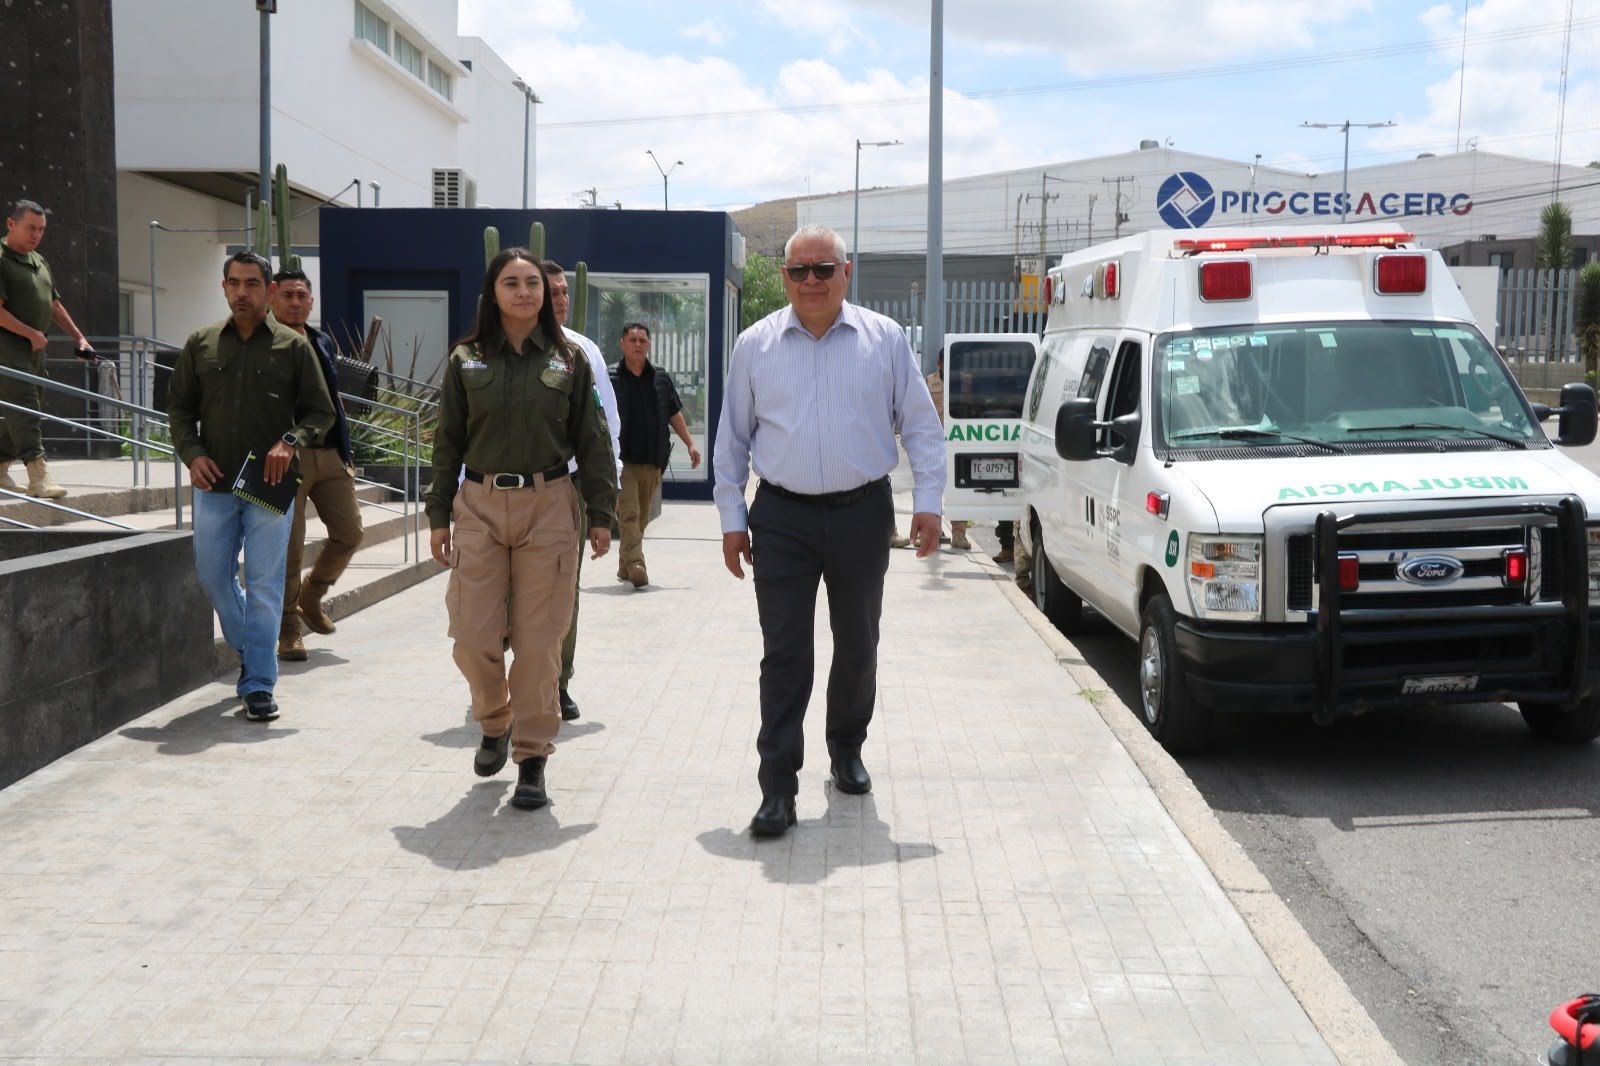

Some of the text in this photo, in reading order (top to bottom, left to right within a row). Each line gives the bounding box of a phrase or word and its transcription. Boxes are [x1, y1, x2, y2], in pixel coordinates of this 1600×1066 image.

[1220, 190, 1474, 216] PROCESACERO
[945, 424, 1021, 442] ANCIA
[972, 463, 1014, 474] TC-0757-E
[1417, 563, 1448, 578] Ford
